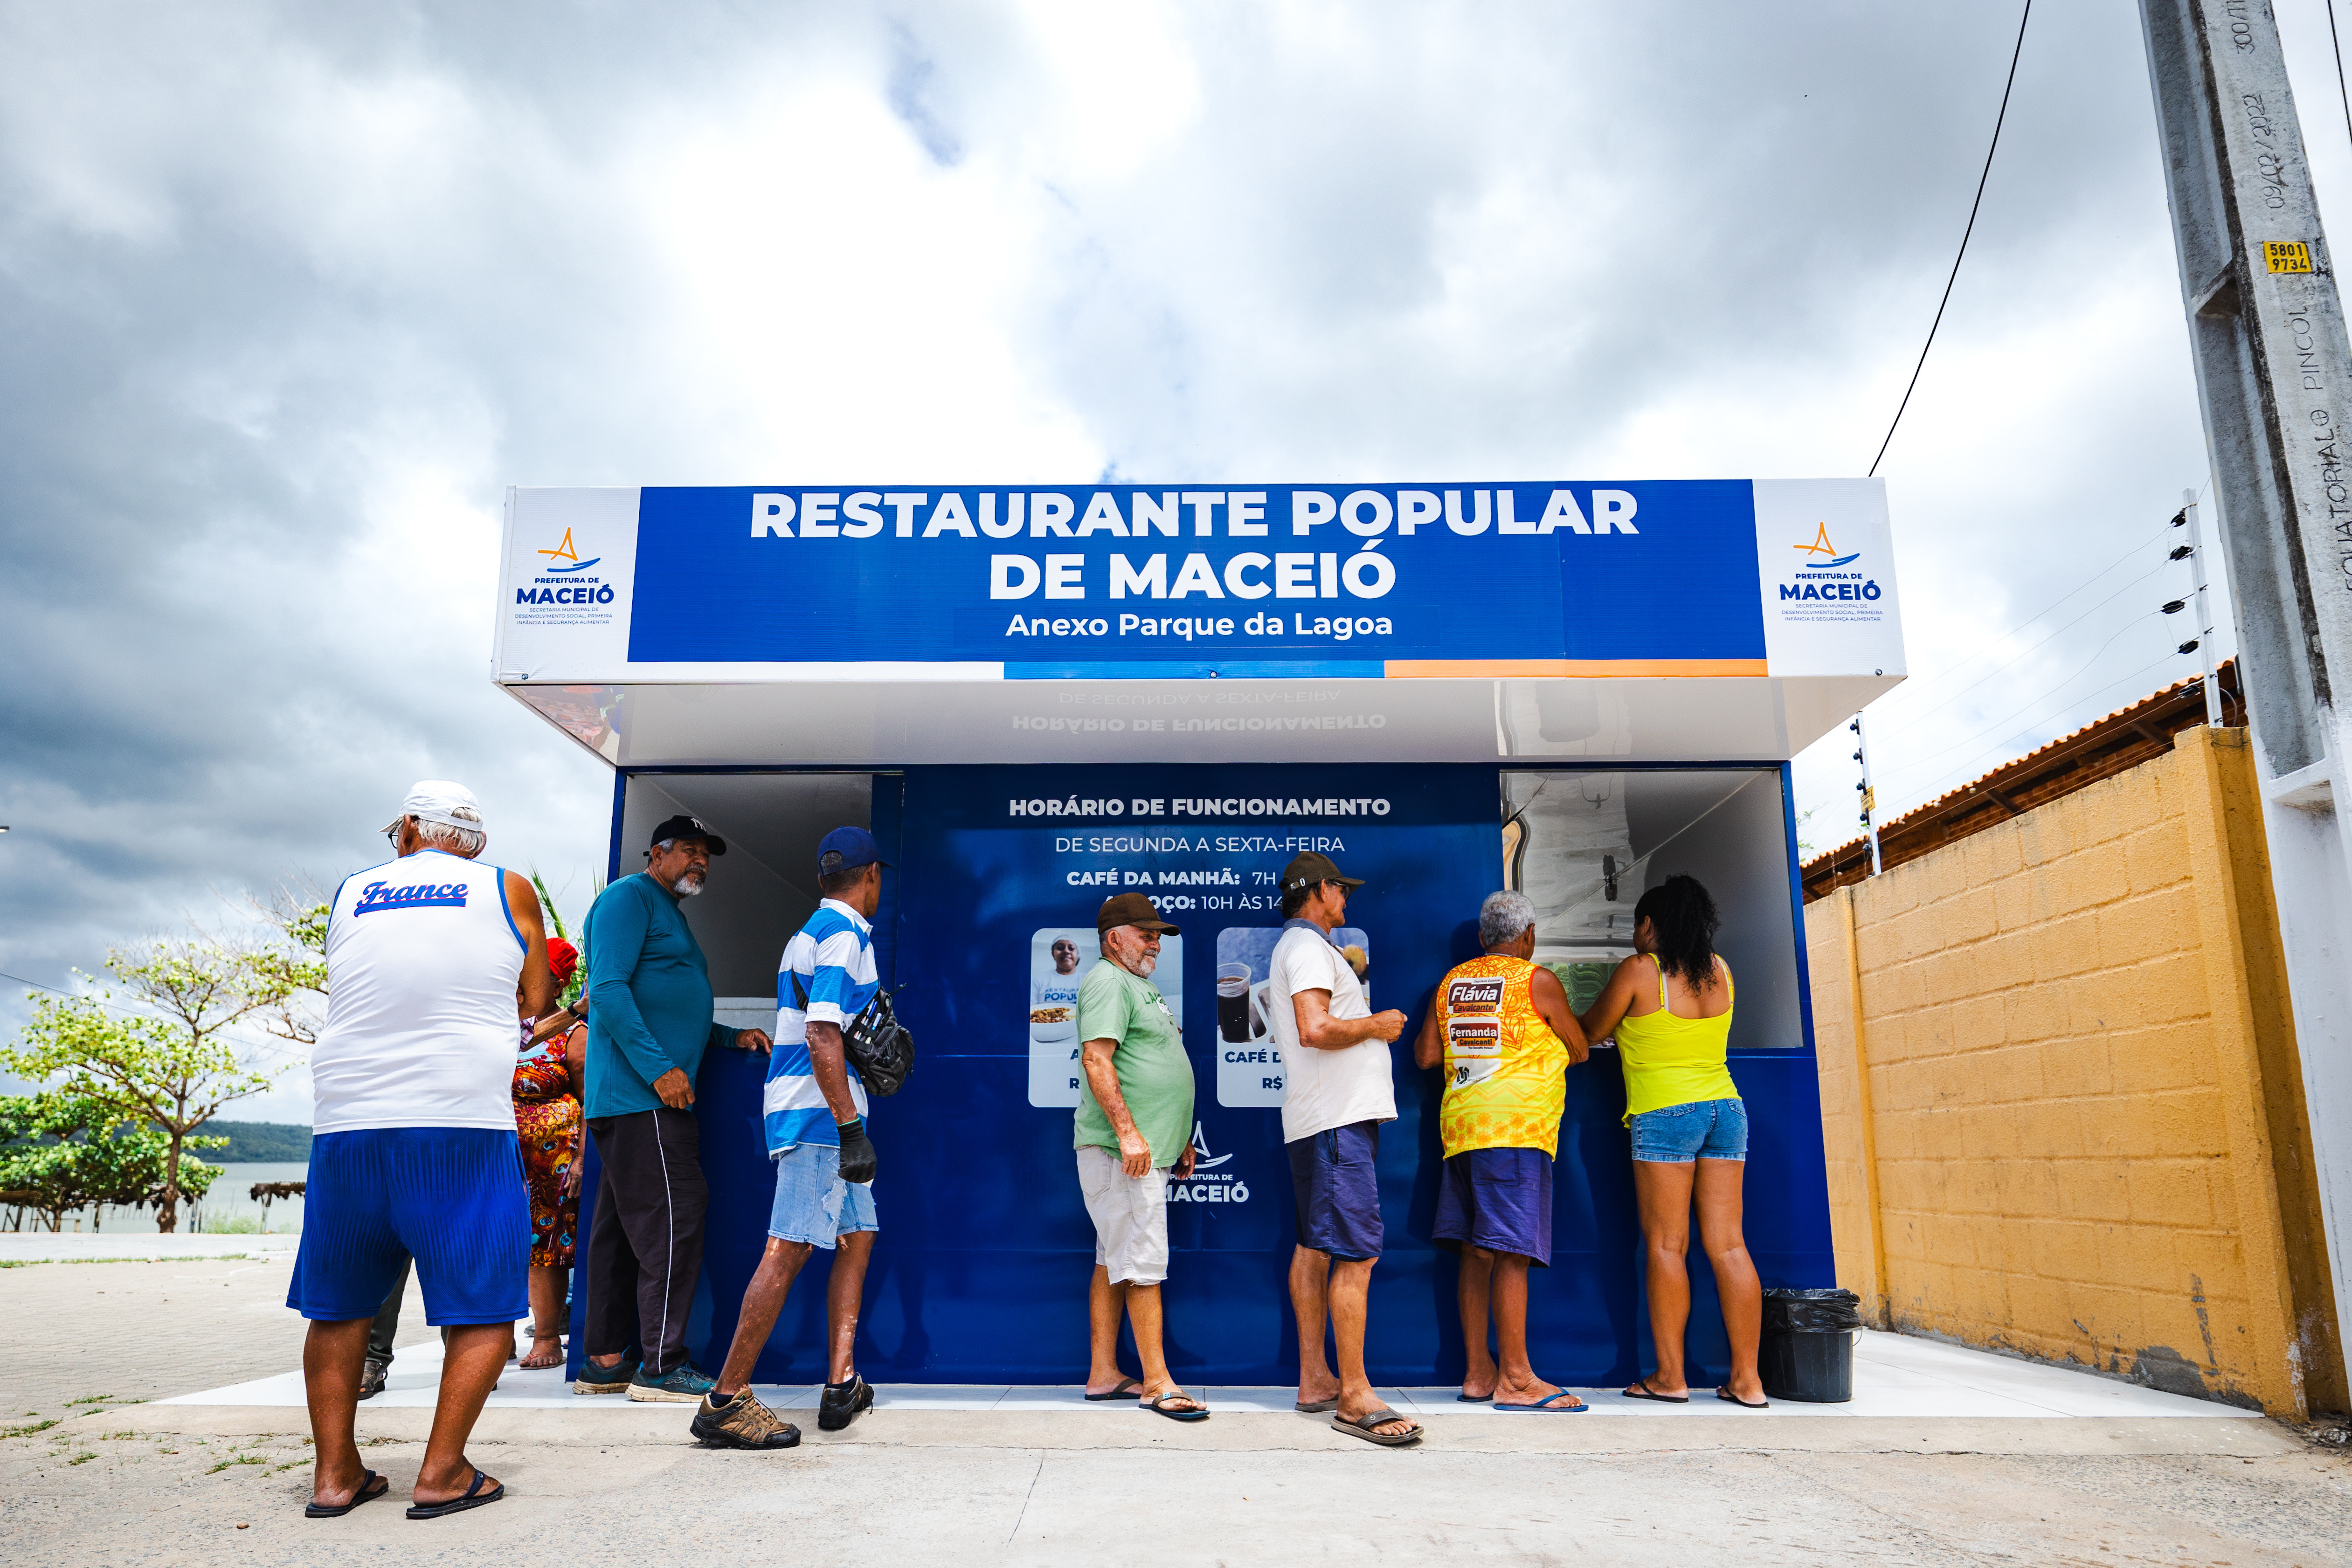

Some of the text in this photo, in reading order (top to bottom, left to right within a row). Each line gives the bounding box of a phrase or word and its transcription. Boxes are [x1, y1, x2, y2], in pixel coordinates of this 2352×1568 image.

[2270, 244, 2303, 256] 5801
[2272, 258, 2307, 270] 9734
[2289, 305, 2324, 390] PINCOL
[751, 490, 1639, 538] RESTAURANTE POPULAR
[990, 539, 1396, 599] DE MACEIÓ
[517, 584, 614, 604] MACEIÓ
[1780, 580, 1881, 600] MACEIÓ
[1005, 612, 1392, 641] Anexo Parque da Lagoa
[1010, 795, 1390, 815] HORÁRIO DE FUNCIONAMENTO
[1056, 837, 1345, 852] DE SEGUNDA A SEXTA-FEIRA
[1067, 868, 1275, 885] CAFÉ DA MANHÃ: 7H
[357, 880, 469, 908] France
[1201, 897, 1232, 909] 10H
[1238, 893, 1262, 909] ÀS
[1045, 993, 1077, 1002] POPUL
[1451, 986, 1498, 1001] Flávia
[1451, 1027, 1497, 1037] Fernanda
[1225, 1049, 1281, 1063] CAFÉ D
[1070, 1078, 1079, 1089] R
[1263, 1076, 1282, 1090] R$
